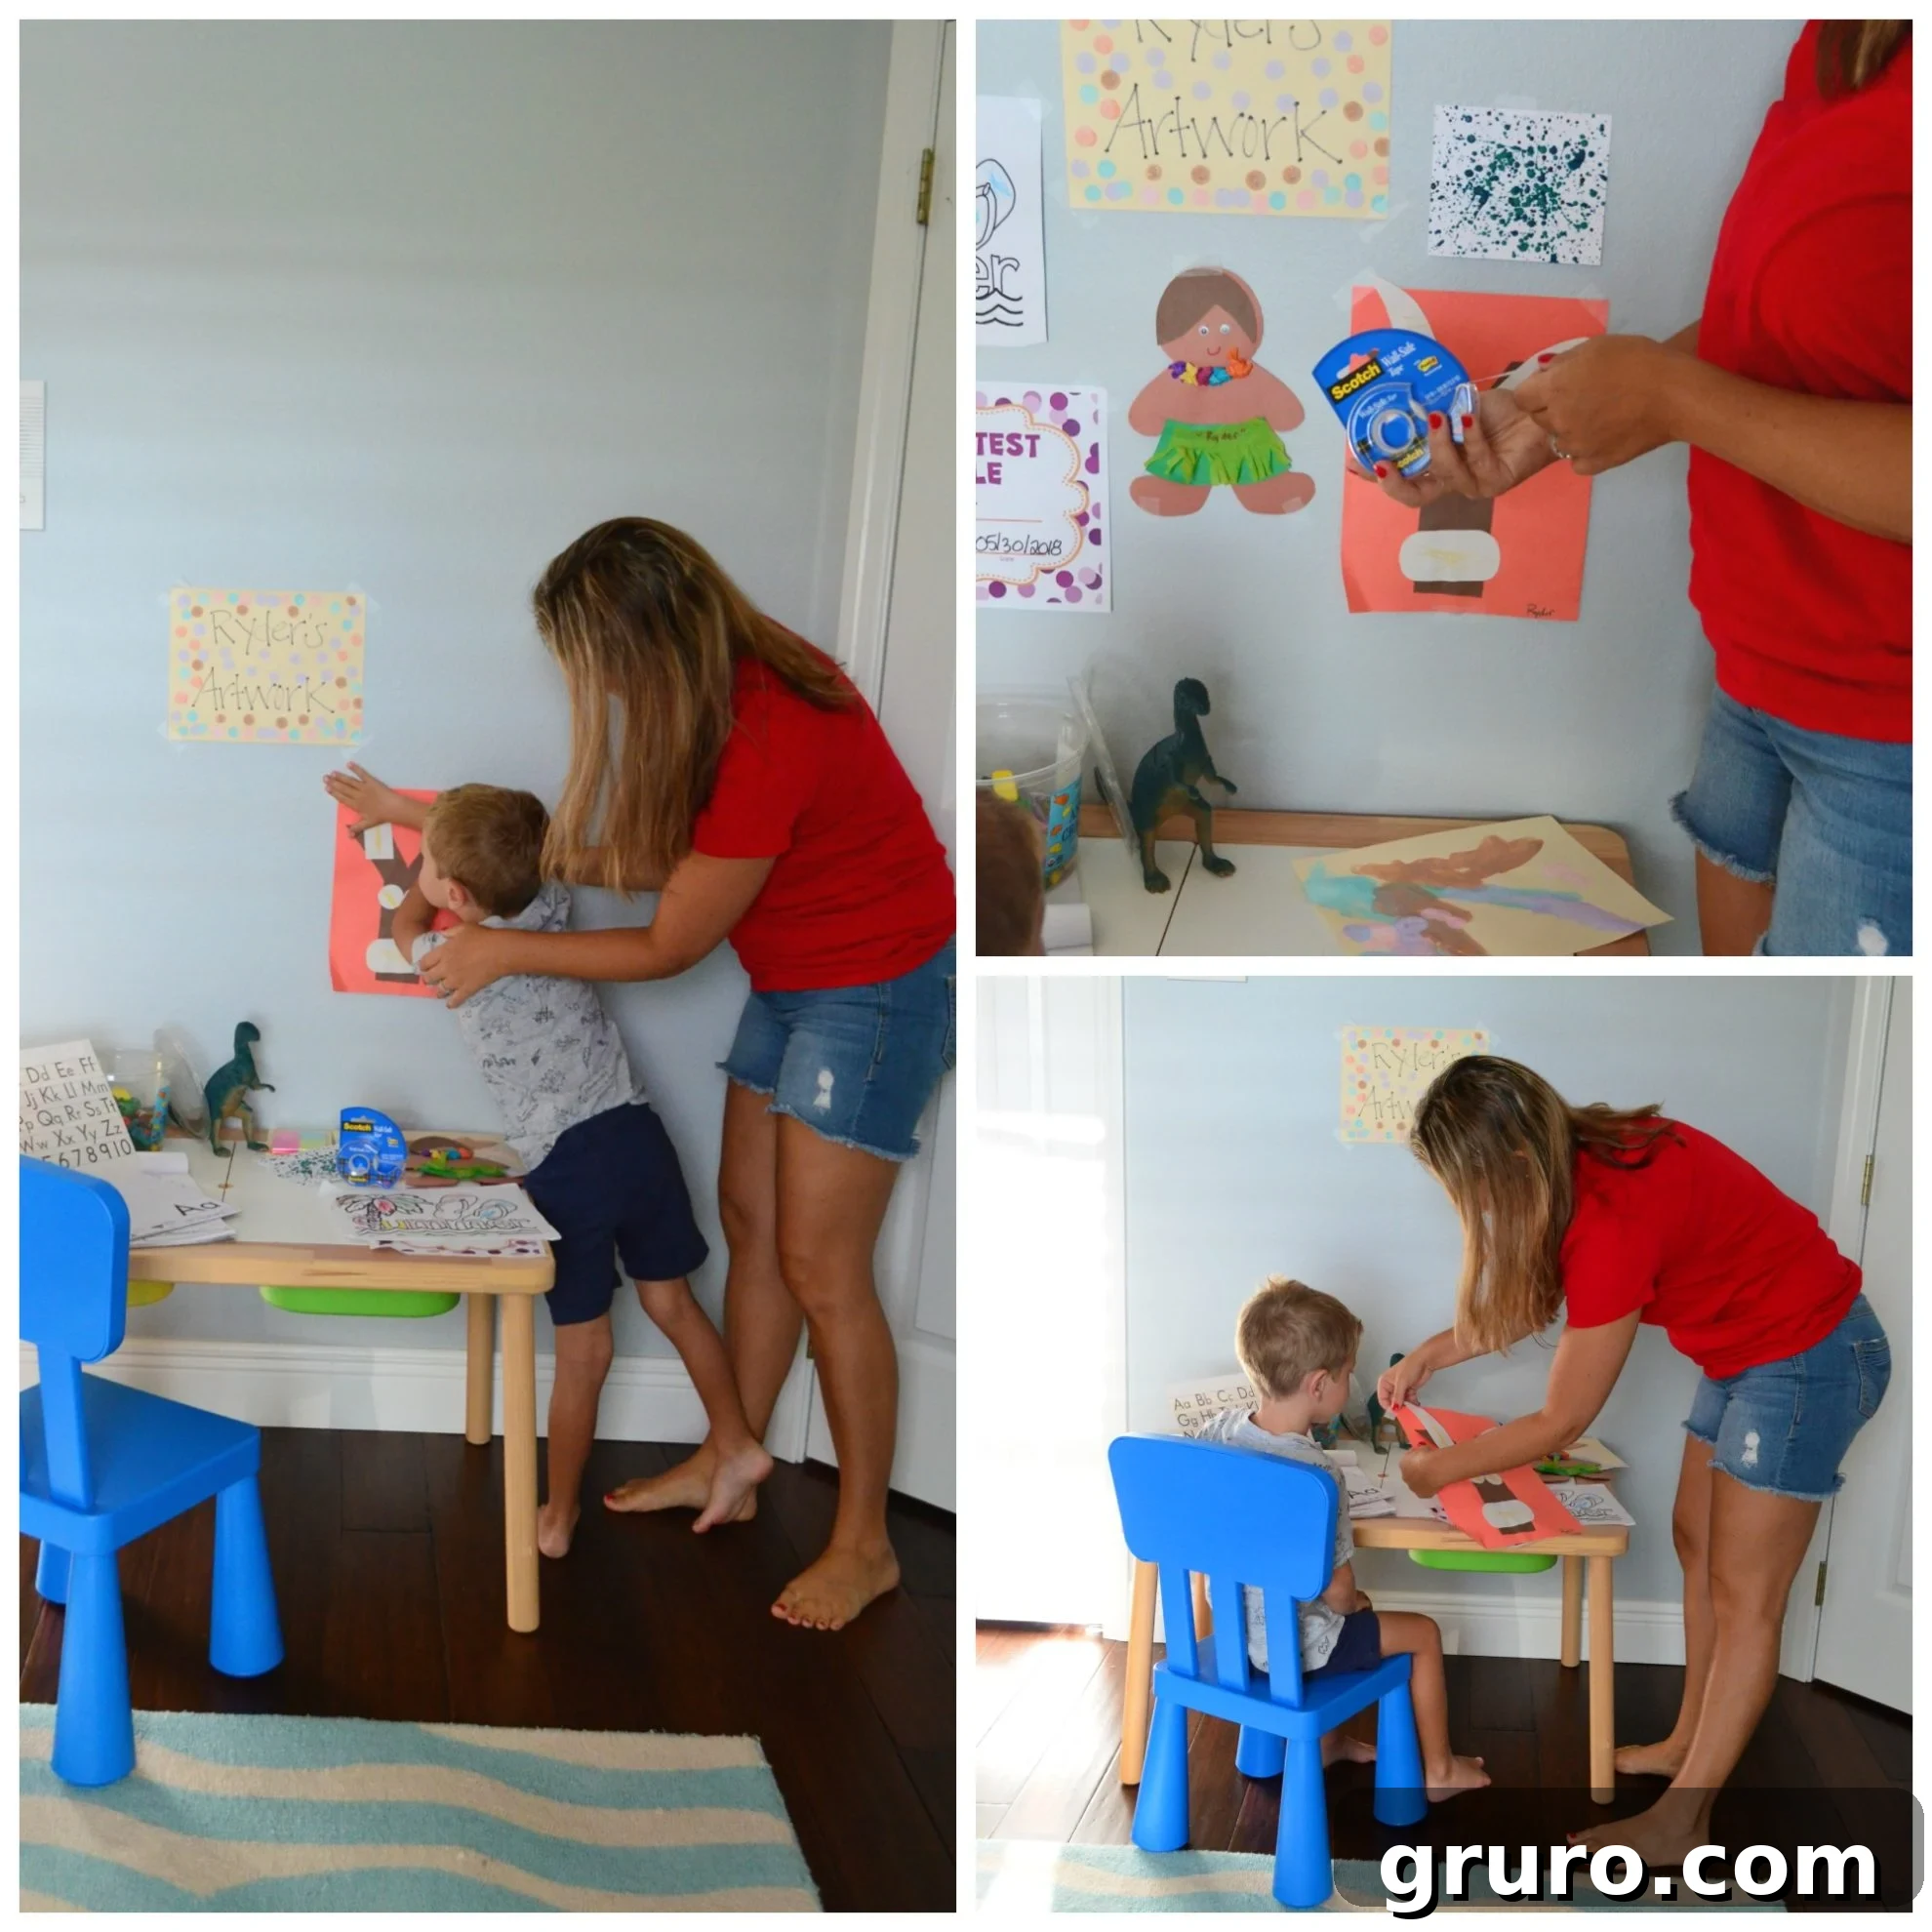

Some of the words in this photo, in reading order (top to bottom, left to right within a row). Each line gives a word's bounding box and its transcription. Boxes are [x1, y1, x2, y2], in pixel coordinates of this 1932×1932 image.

[1105, 82, 1344, 164] Artwork
[1330, 361, 1382, 401] Scotch
[210, 609, 328, 656] Ryler's
[191, 666, 335, 714] Artwork
[25, 1065, 51, 1083] Dd
[55, 1062, 74, 1078] Ee
[78, 1056, 95, 1073] Ff
[39, 1085, 61, 1104] Kk
[81, 1080, 108, 1096] Mm
[36, 1109, 63, 1126] Qq
[64, 1105, 81, 1121] Rr
[84, 1101, 101, 1117] Ss
[100, 1097, 117, 1113] Tt
[52, 1129, 76, 1147] Xx
[76, 1124, 97, 1144] Yy
[101, 1119, 123, 1137] Zz
[174, 1202, 221, 1216] Aa
[1174, 1398, 1190, 1411] Aa
[1194, 1392, 1212, 1407] Bb
[1217, 1389, 1234, 1403] Cc
[1236, 1386, 1256, 1399] Dd
[1177, 1414, 1199, 1428] Gg
[1348, 1488, 1381, 1500] Aa
